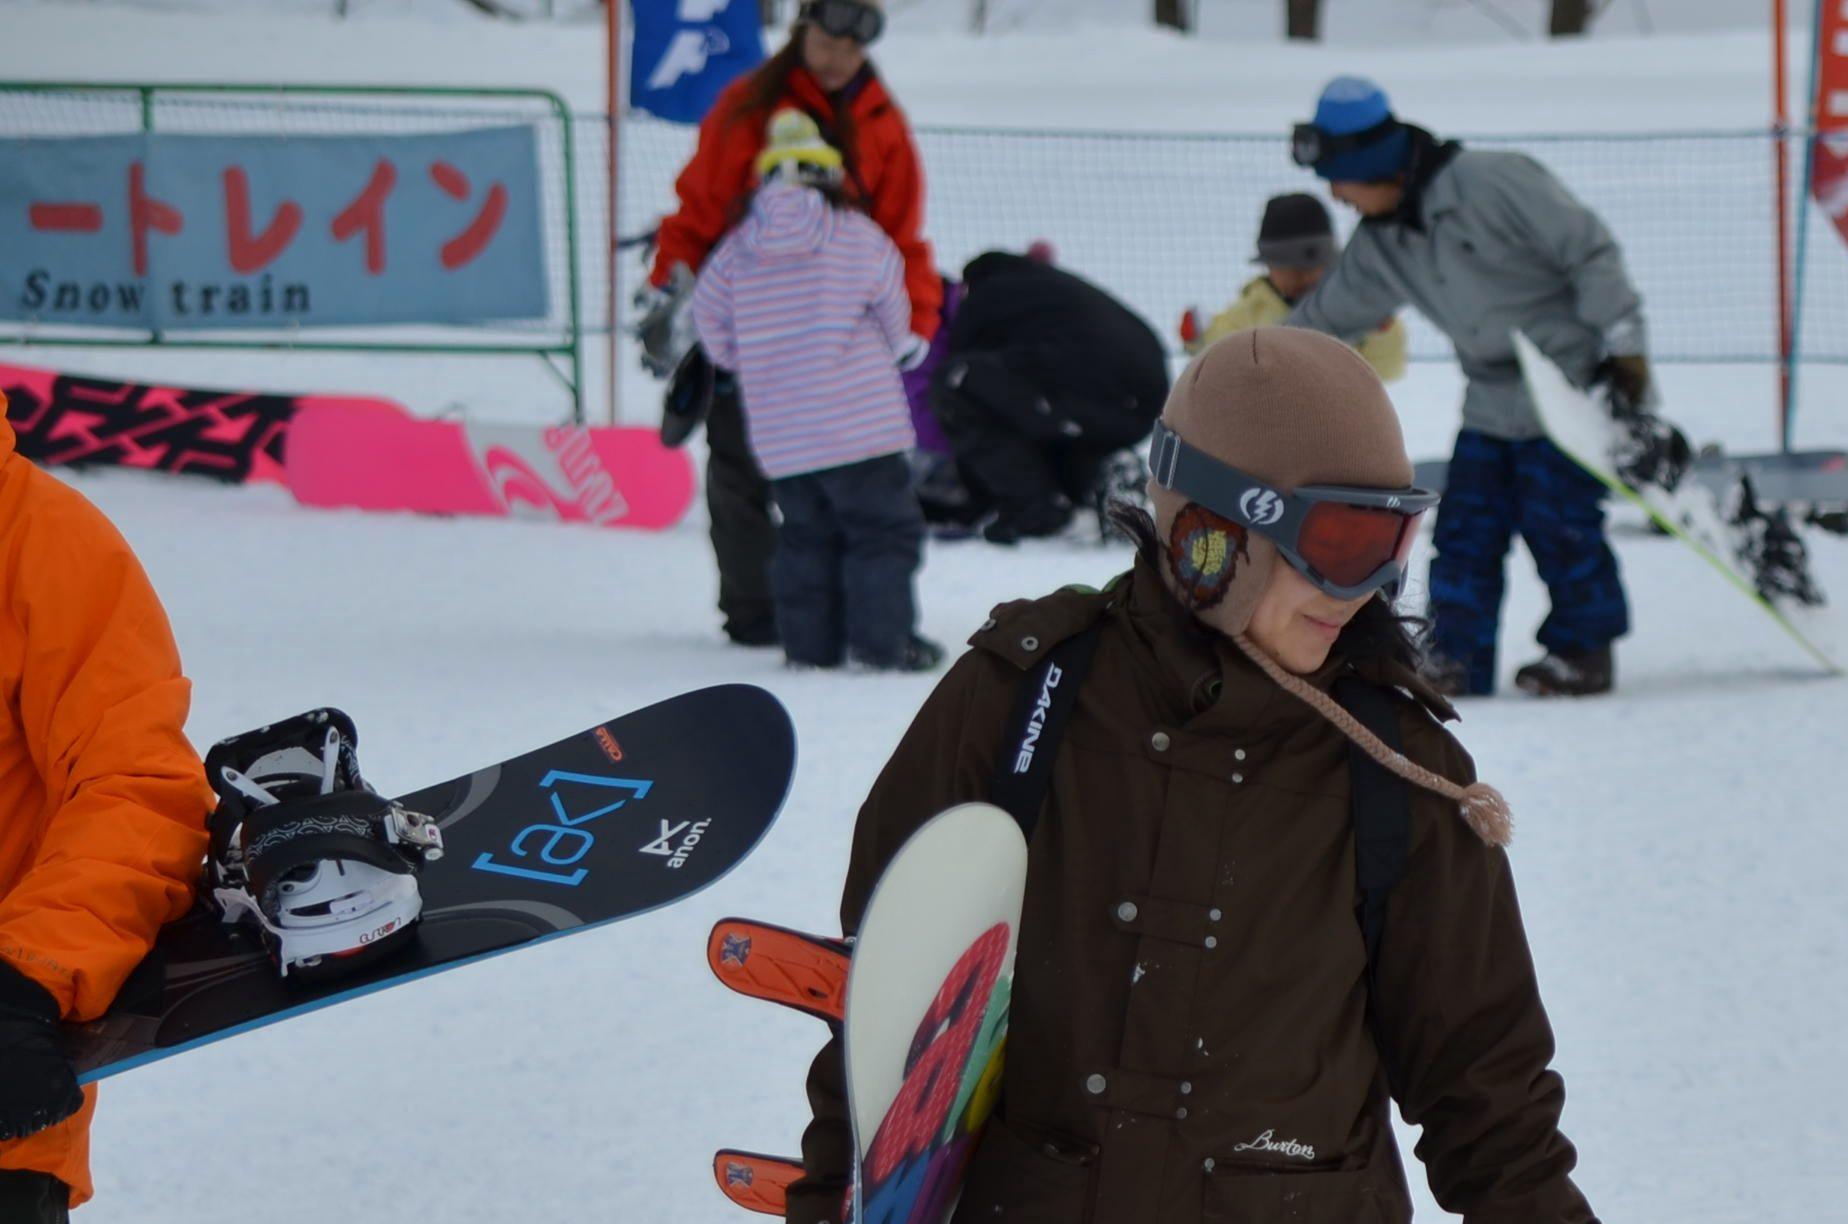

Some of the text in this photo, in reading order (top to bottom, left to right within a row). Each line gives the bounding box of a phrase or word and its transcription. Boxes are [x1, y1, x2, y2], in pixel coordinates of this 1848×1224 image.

[21, 268, 312, 315] Snow train
[1013, 661, 1063, 774] DAKINE
[1233, 1129, 1315, 1160] Burton
